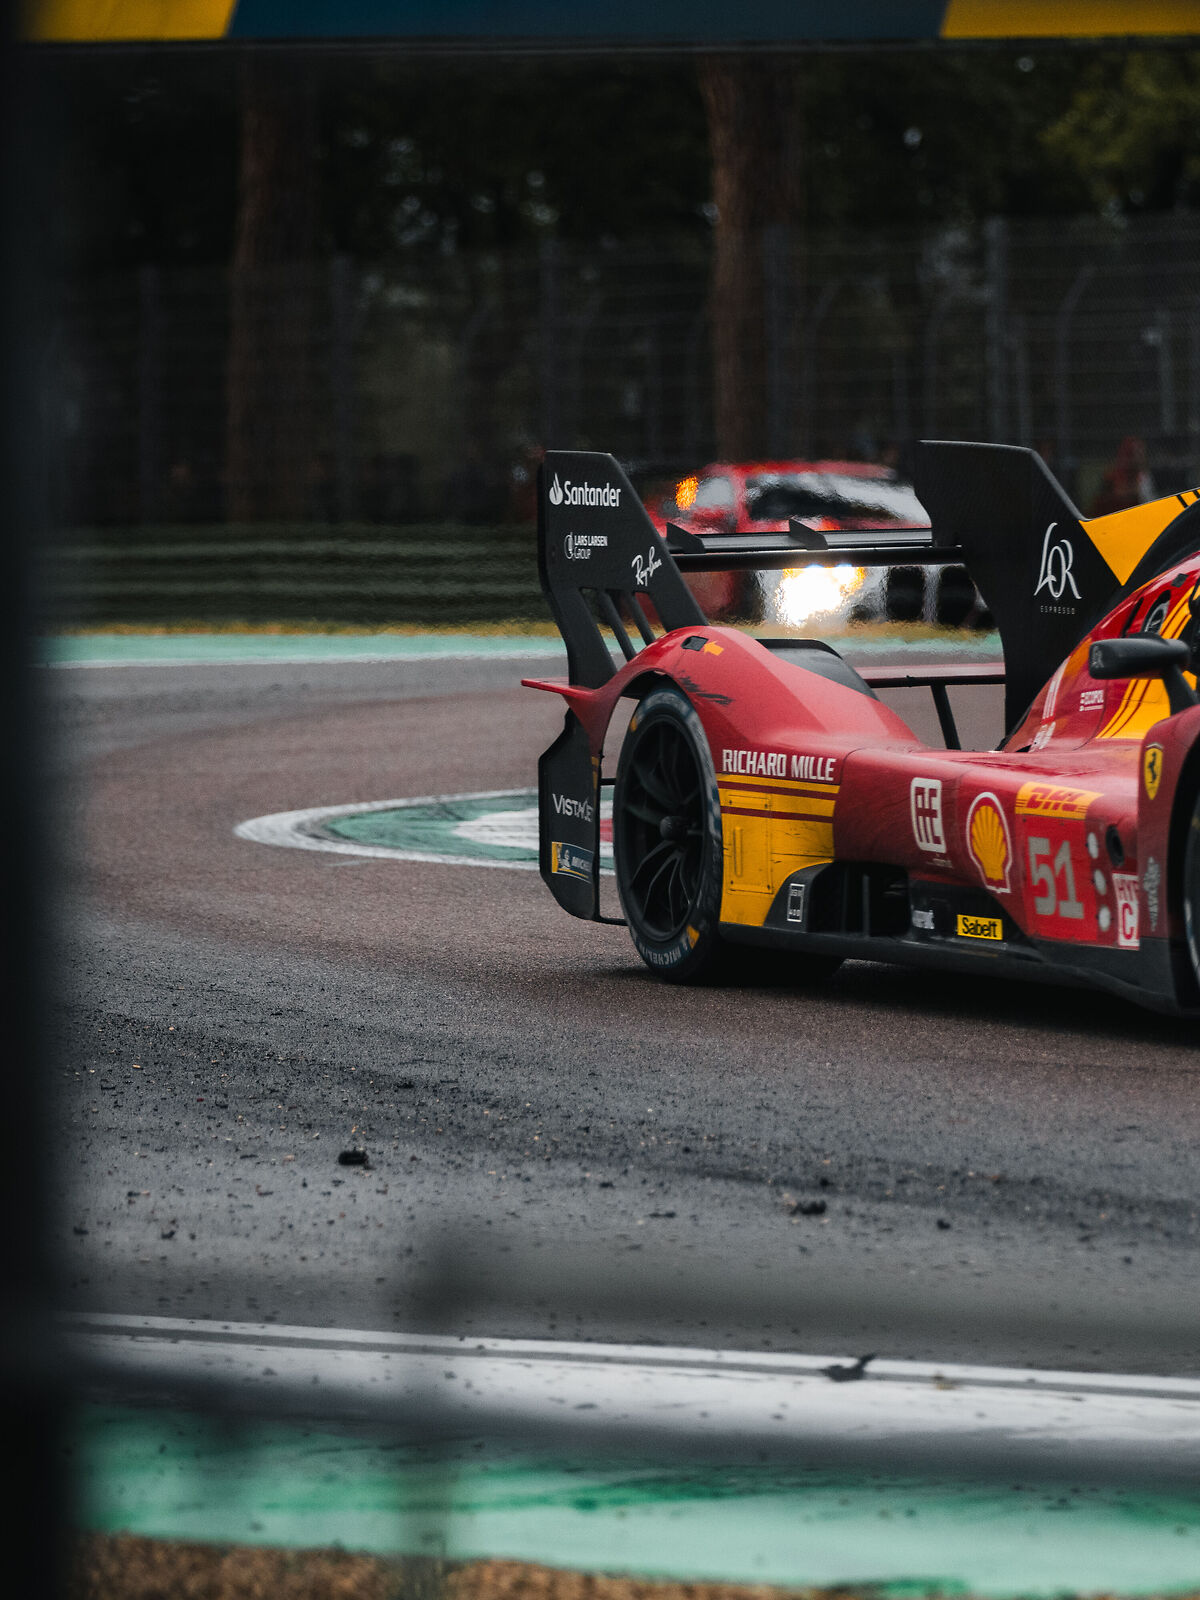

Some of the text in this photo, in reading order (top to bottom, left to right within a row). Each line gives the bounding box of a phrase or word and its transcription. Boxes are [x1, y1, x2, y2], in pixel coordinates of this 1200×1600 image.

[564, 480, 621, 507] Santander
[574, 535, 608, 546] LARS LARSEN
[722, 749, 836, 781] RICHARD MILLE
[1027, 787, 1086, 812] DHL
[1028, 836, 1085, 919] 51
[962, 917, 998, 938] Sabelt
